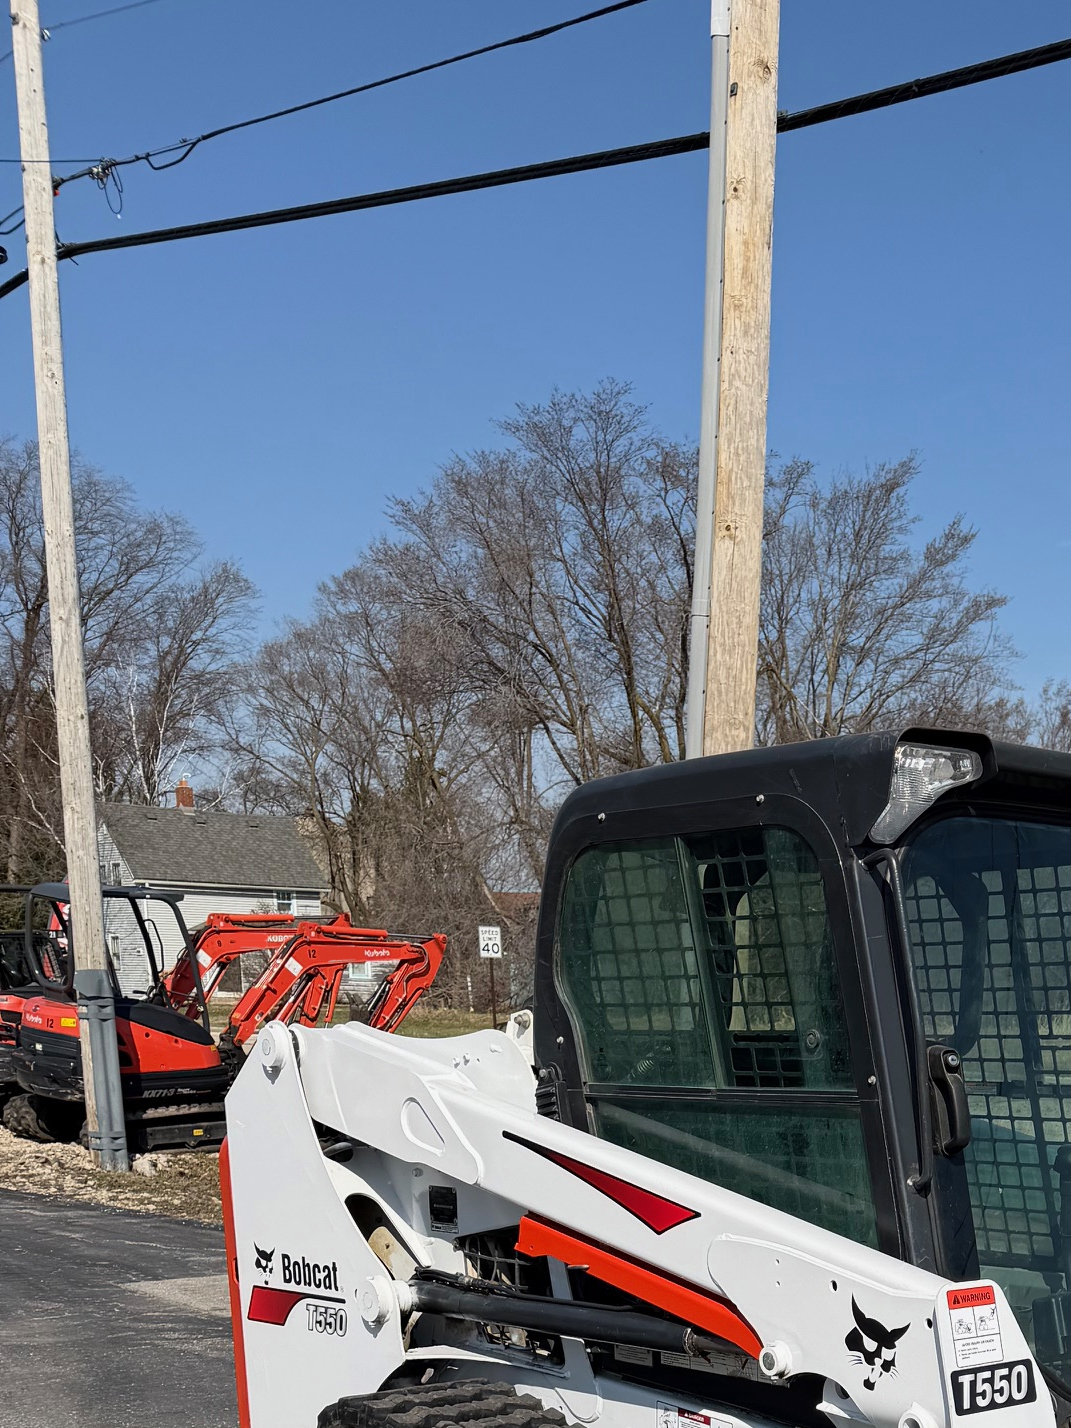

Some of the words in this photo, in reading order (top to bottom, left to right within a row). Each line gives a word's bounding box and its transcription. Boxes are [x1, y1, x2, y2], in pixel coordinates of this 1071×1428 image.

[308, 949, 317, 958] 12
[482, 943, 500, 954] 40
[47, 1018, 54, 1028] 12
[281, 1253, 339, 1291] Bobcat
[960, 1292, 991, 1304] WARNING
[306, 1303, 348, 1337] T550
[958, 1364, 1028, 1410] T550
